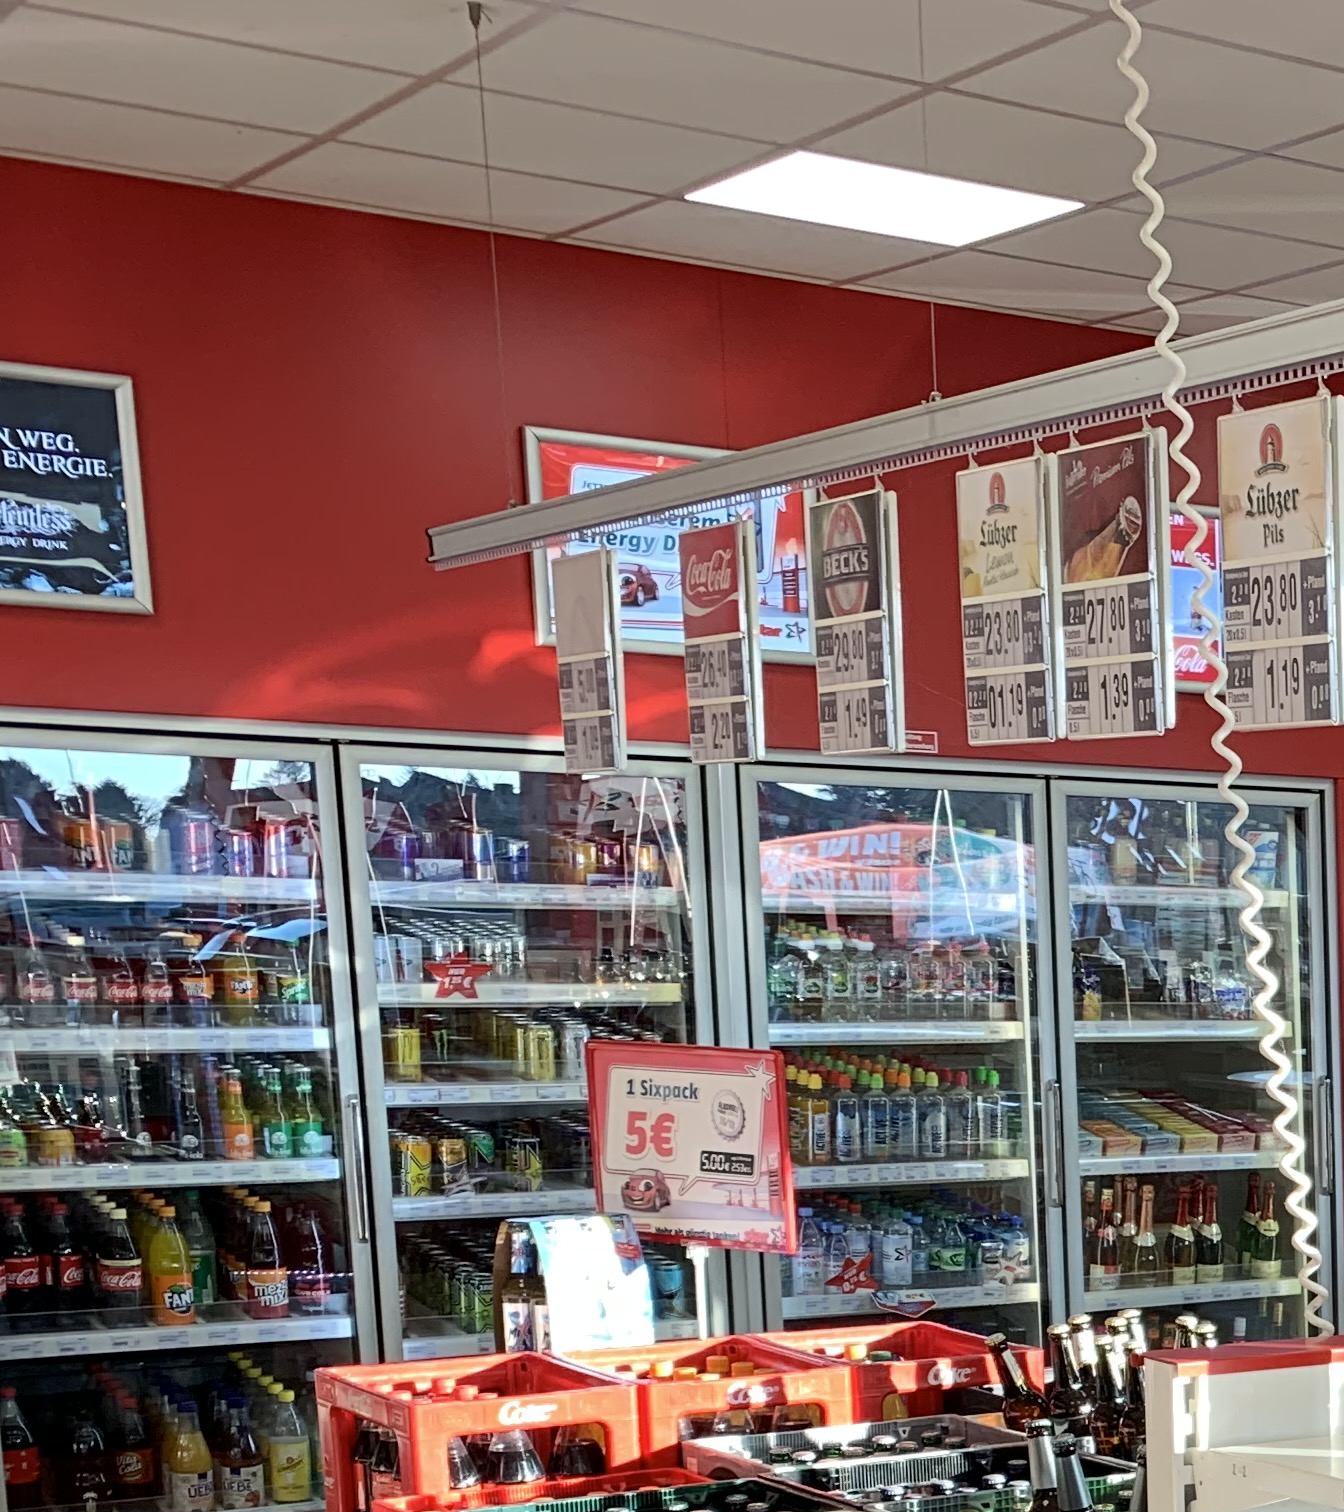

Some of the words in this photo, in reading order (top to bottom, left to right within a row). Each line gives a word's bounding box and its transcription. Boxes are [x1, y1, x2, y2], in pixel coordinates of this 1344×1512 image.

[16, 428, 80, 453] WEG.
[3, 450, 113, 478] ENERGIE.
[0, 499, 73, 537] lentless
[1245, 484, 1300, 519] Lübzer
[979, 519, 1018, 549] Lübzer
[1262, 522, 1285, 548] Pils
[823, 549, 869, 579] BECK'S
[1251, 572, 1297, 627] 23.80
[984, 609, 1020, 656] 23.80
[1086, 595, 1126, 645] 27.80
[701, 648, 728, 690] 26.40
[833, 629, 865, 673] 29.80
[1100, 672, 1129, 721] 1.39
[1266, 657, 1300, 710] 1.19
[711, 710, 731, 750] 2.20
[843, 697, 868, 739] 1.49
[626, 1078, 635, 1096] 1
[640, 1078, 698, 1102] Sixpack
[625, 1110, 676, 1158] 5€
[163, 1290, 195, 1309] FANT
[927, 1362, 977, 1386] Coke
